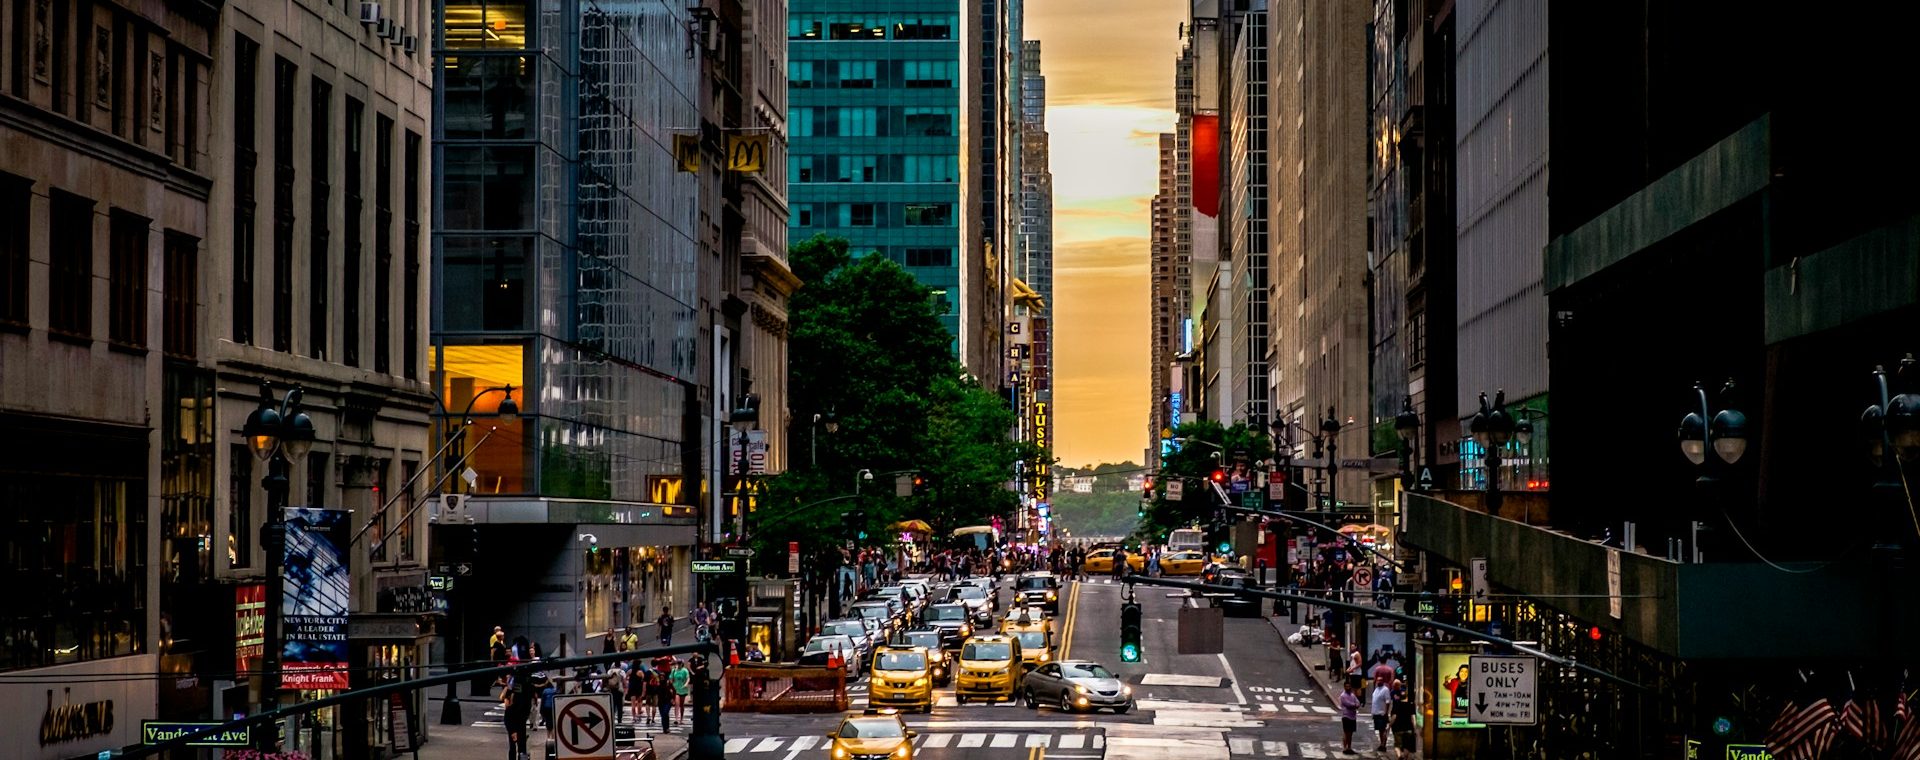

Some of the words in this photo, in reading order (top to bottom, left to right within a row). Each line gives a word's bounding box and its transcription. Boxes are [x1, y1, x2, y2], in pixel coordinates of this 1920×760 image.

[1035, 402, 1046, 499] TUSSUDS
[693, 563, 720, 571] Madison
[283, 616, 301, 624] NEW
[303, 616, 325, 624] YORK
[326, 617, 348, 625] CITY:
[319, 633, 347, 641] ESTATE
[1481, 662, 1524, 673] BUSES
[282, 674, 309, 684] Knight
[311, 674, 334, 683] Frank
[1486, 676, 1519, 687] ONLY
[1248, 686, 1314, 694] ONLY
[220, 730, 247, 741] Ave
[1729, 749, 1775, 760] Vande
